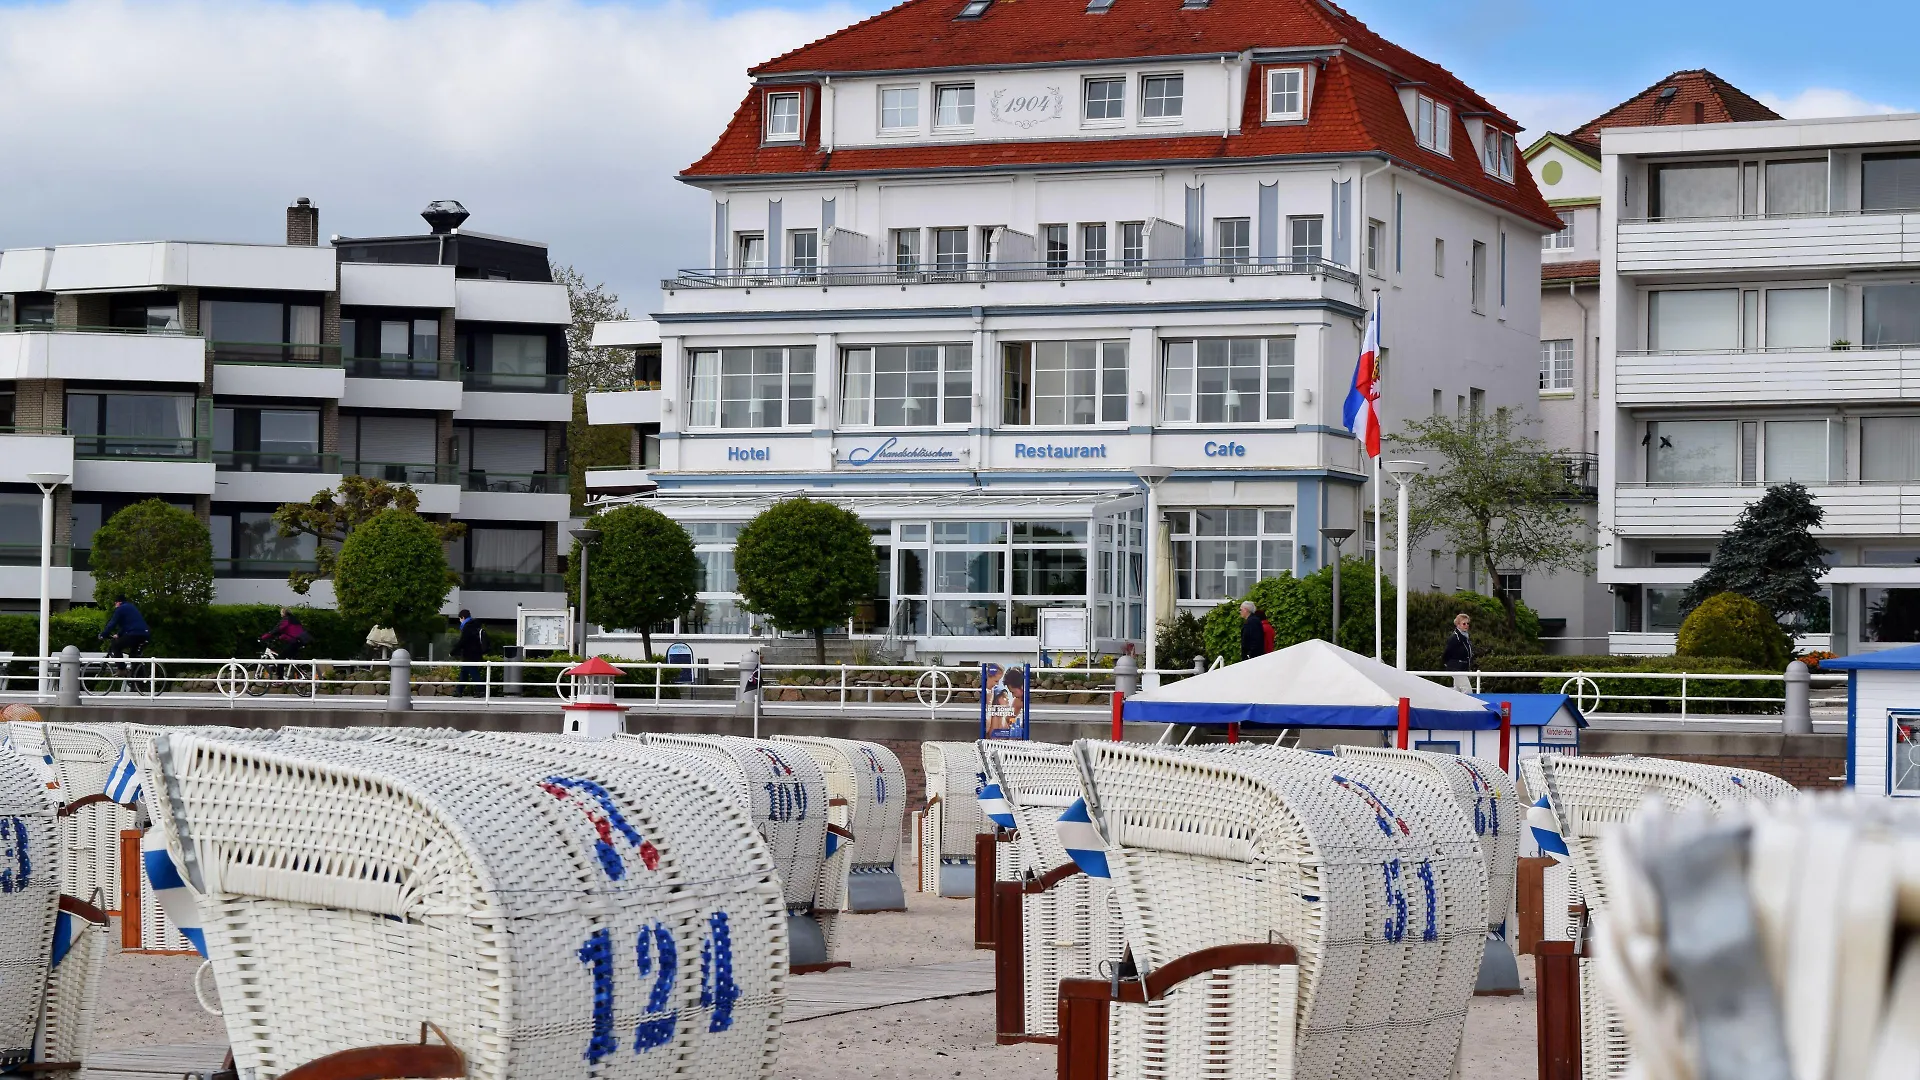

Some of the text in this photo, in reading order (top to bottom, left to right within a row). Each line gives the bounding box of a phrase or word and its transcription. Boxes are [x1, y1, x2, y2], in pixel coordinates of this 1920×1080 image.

[1004, 95, 1050, 113] 1904
[727, 446, 770, 461] Hotel
[848, 437, 953, 467] Strandschlösschen
[1014, 443, 1107, 459] Restaurant
[1204, 441, 1246, 457] Cafe
[1383, 858, 1438, 943] 51
[577, 911, 743, 1066] 124
